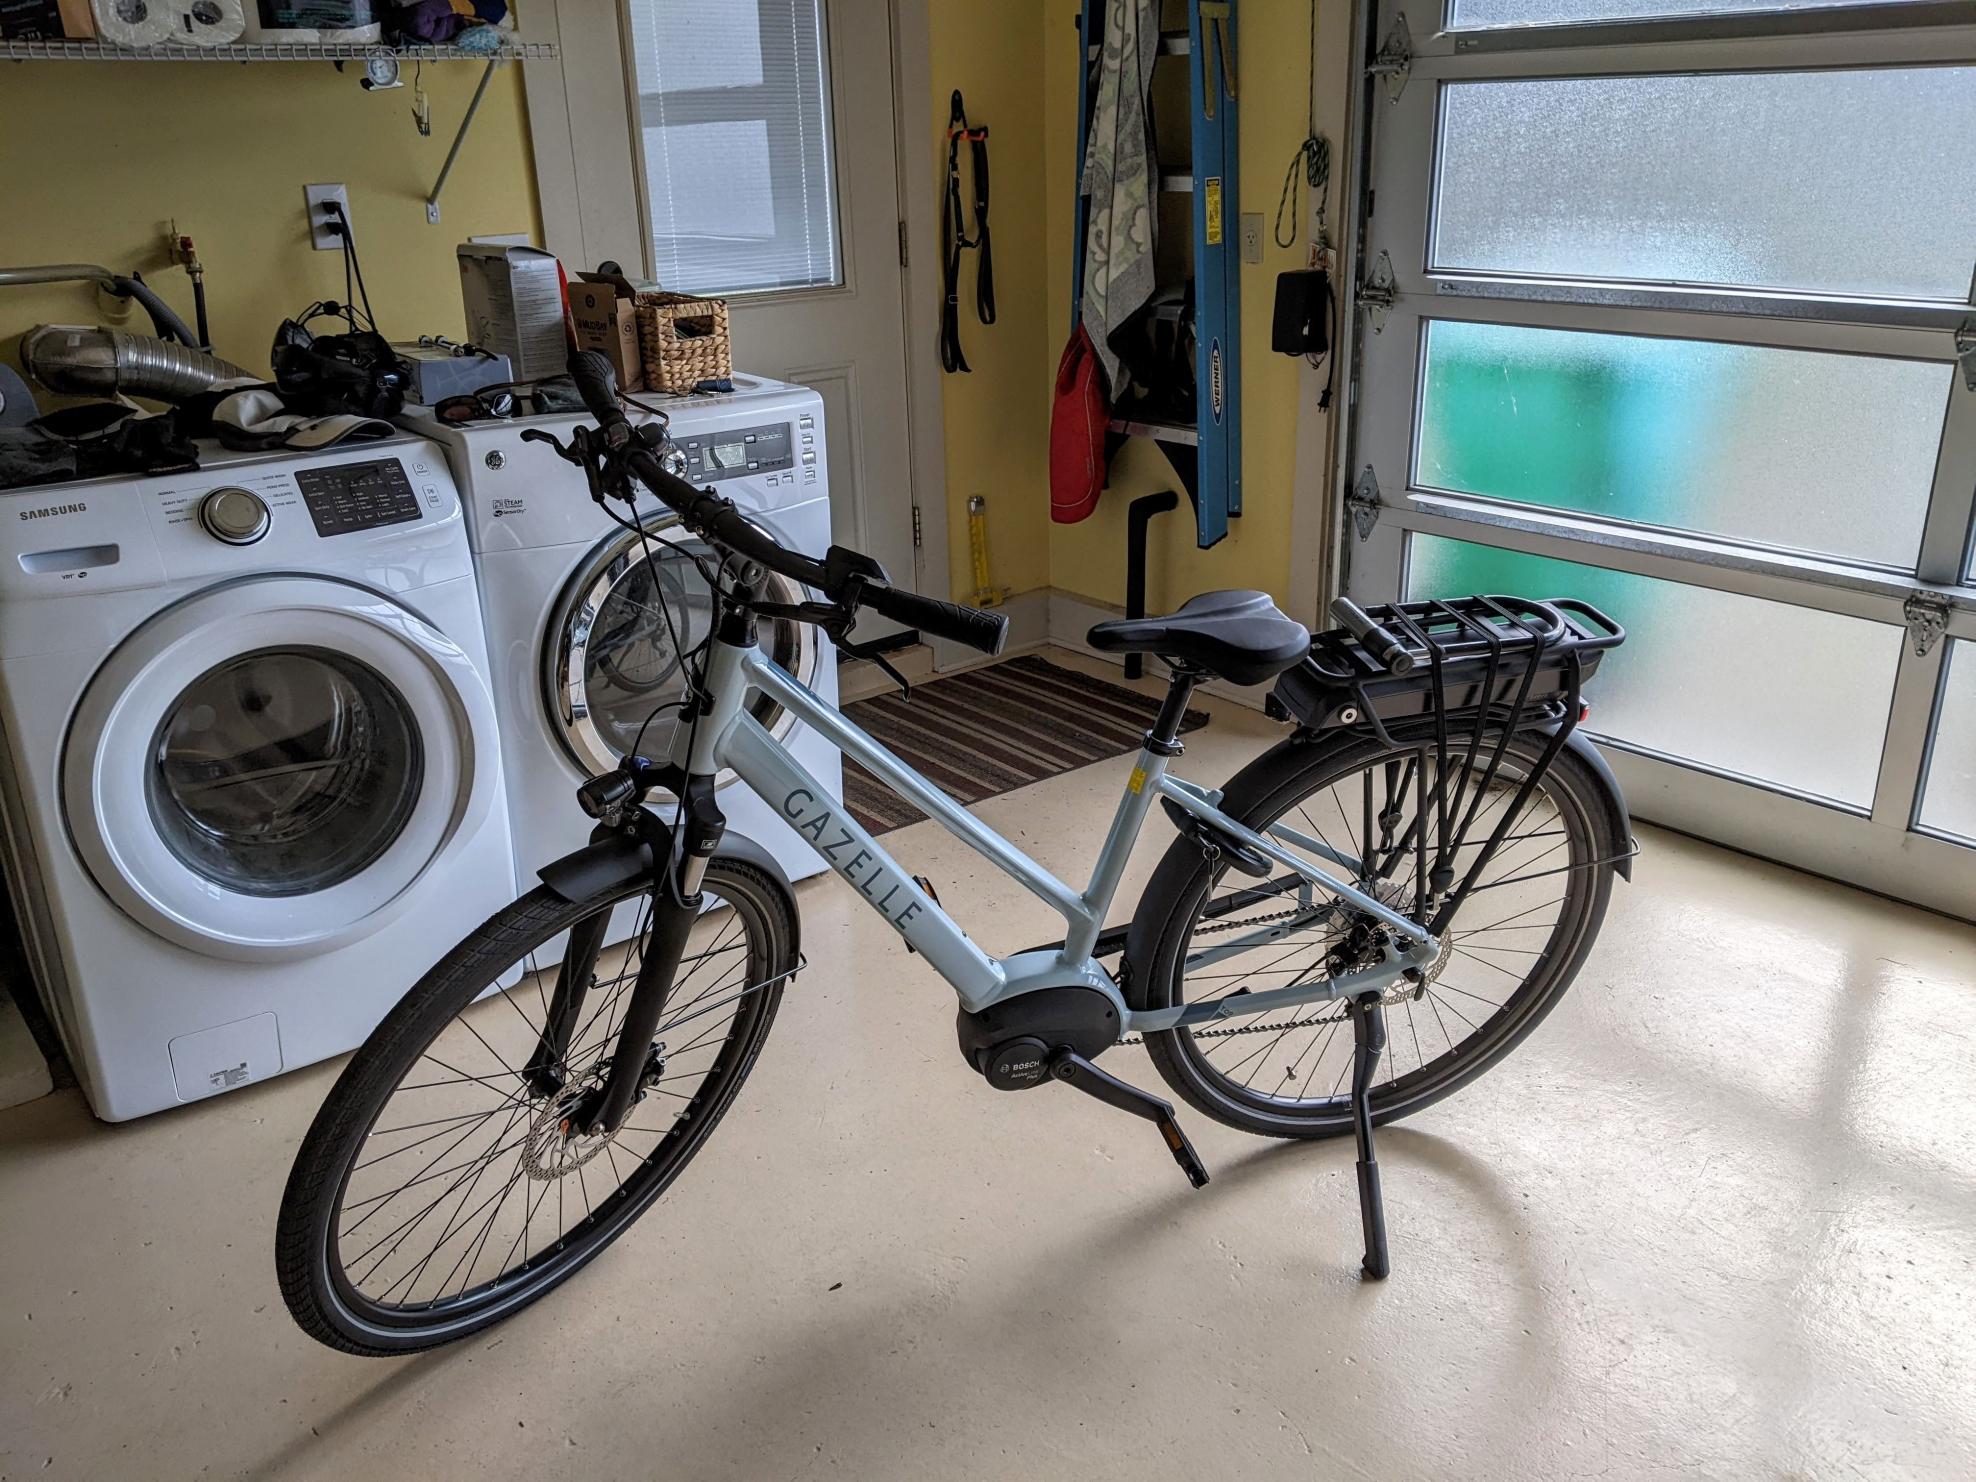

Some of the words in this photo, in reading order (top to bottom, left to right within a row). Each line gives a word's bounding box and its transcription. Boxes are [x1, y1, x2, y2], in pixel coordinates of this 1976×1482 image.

[19, 502, 87, 521] SAMSUNG
[783, 788, 923, 930] GAZELLE
[1013, 1060, 1040, 1071] BOSCH
